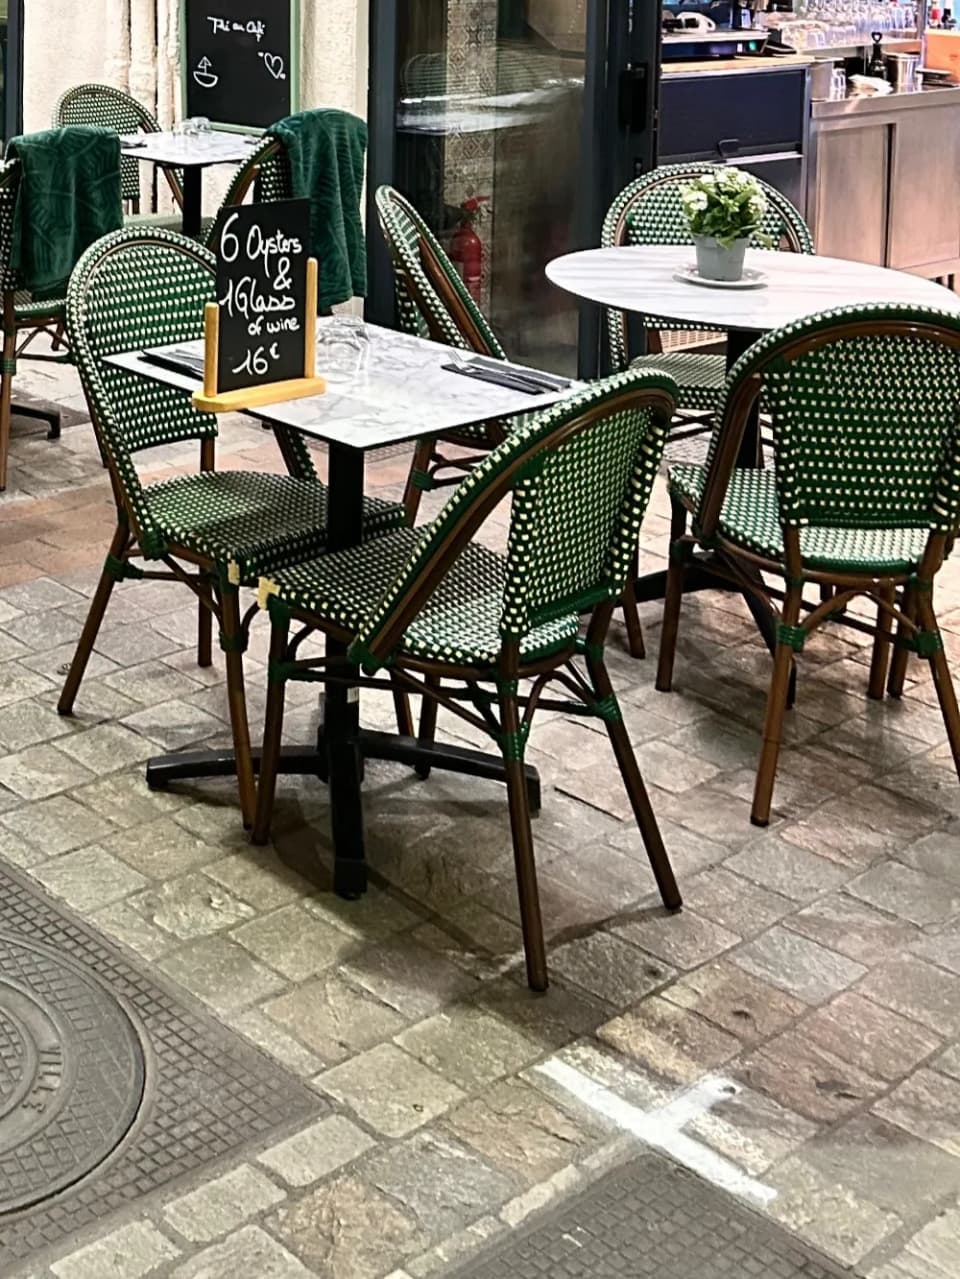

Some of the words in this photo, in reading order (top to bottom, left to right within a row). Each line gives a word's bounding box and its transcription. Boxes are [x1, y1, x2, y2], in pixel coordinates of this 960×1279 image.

[220, 211, 240, 263] 6
[245, 224, 303, 279] Oysters
[272, 255, 293, 291] &
[247, 315, 265, 336] of
[266, 316, 301, 334] wine
